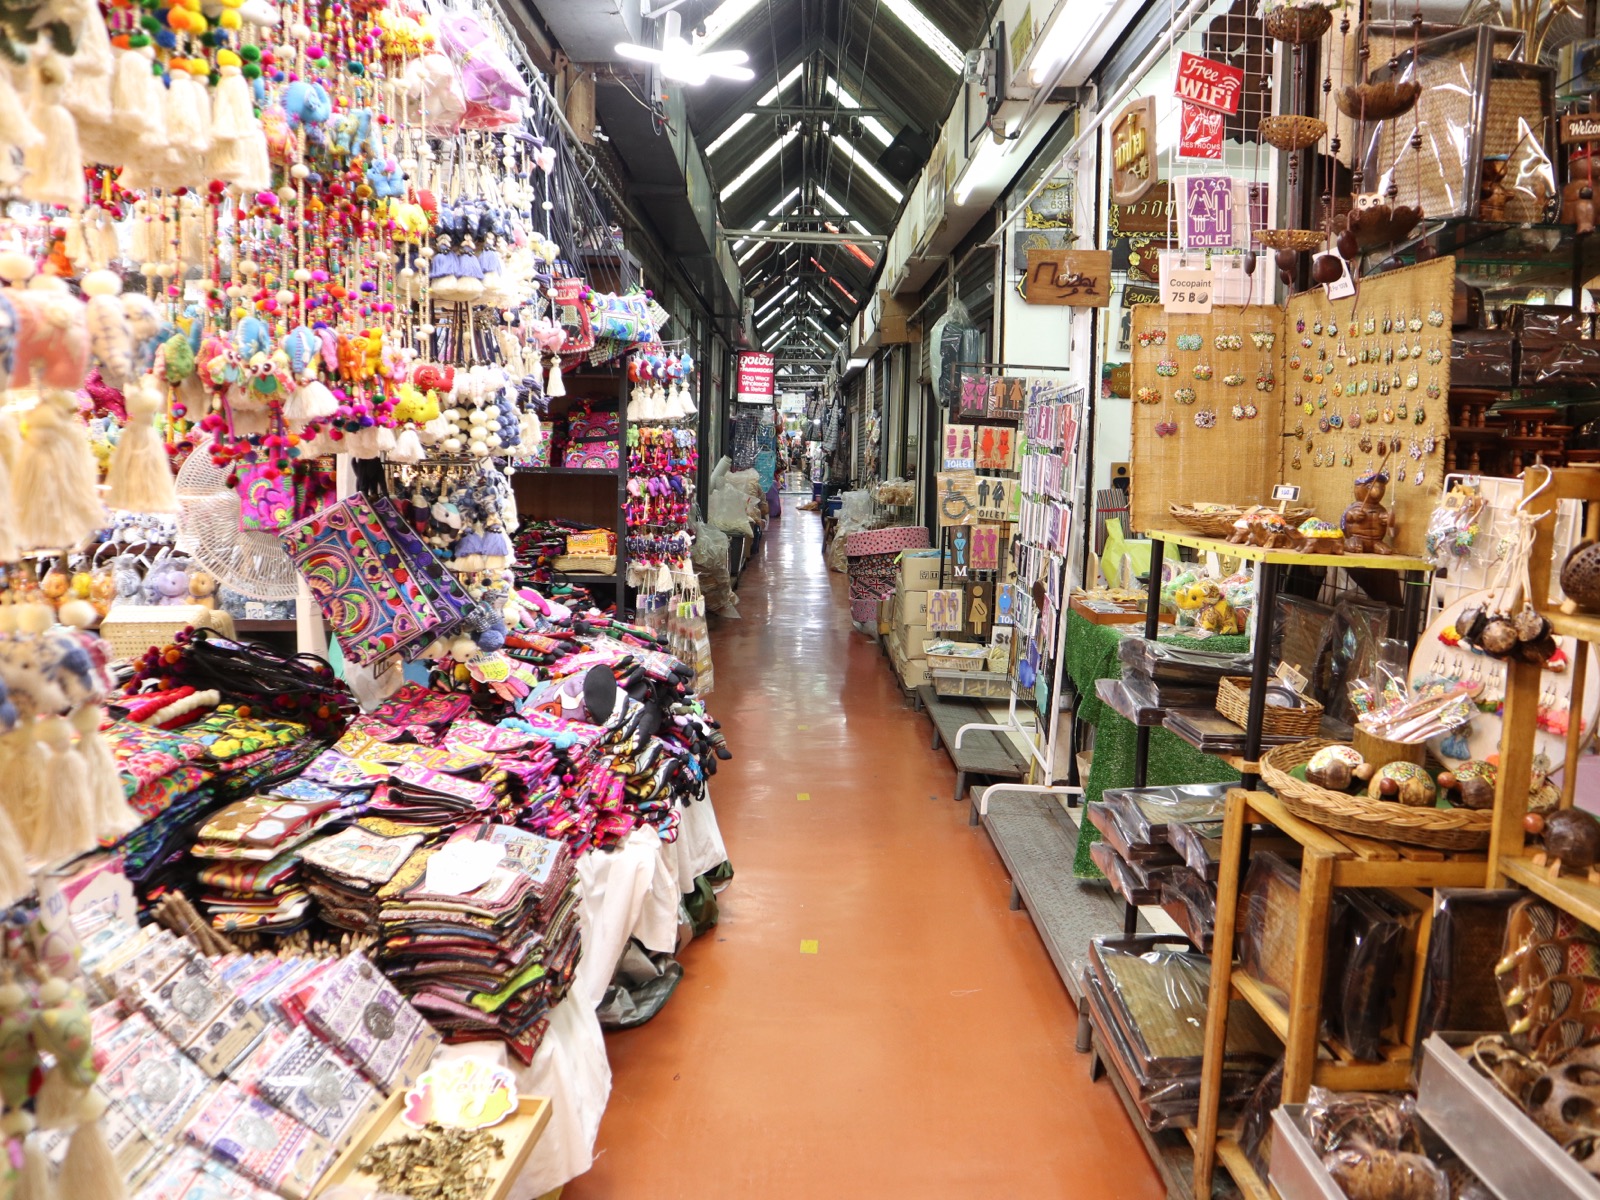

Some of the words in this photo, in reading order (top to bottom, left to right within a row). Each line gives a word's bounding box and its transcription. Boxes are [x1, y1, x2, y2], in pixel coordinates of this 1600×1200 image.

[1183, 57, 1220, 82] Free
[1179, 75, 1233, 110] WiFi
[1188, 234, 1231, 246] TOILET
[1169, 278, 1212, 289] Cocopaint
[1171, 292, 1186, 303] 75
[946, 460, 972, 468] TOILET
[979, 460, 1007, 469] Toilet
[977, 509, 1006, 520] OILET
[953, 565, 968, 577] M
